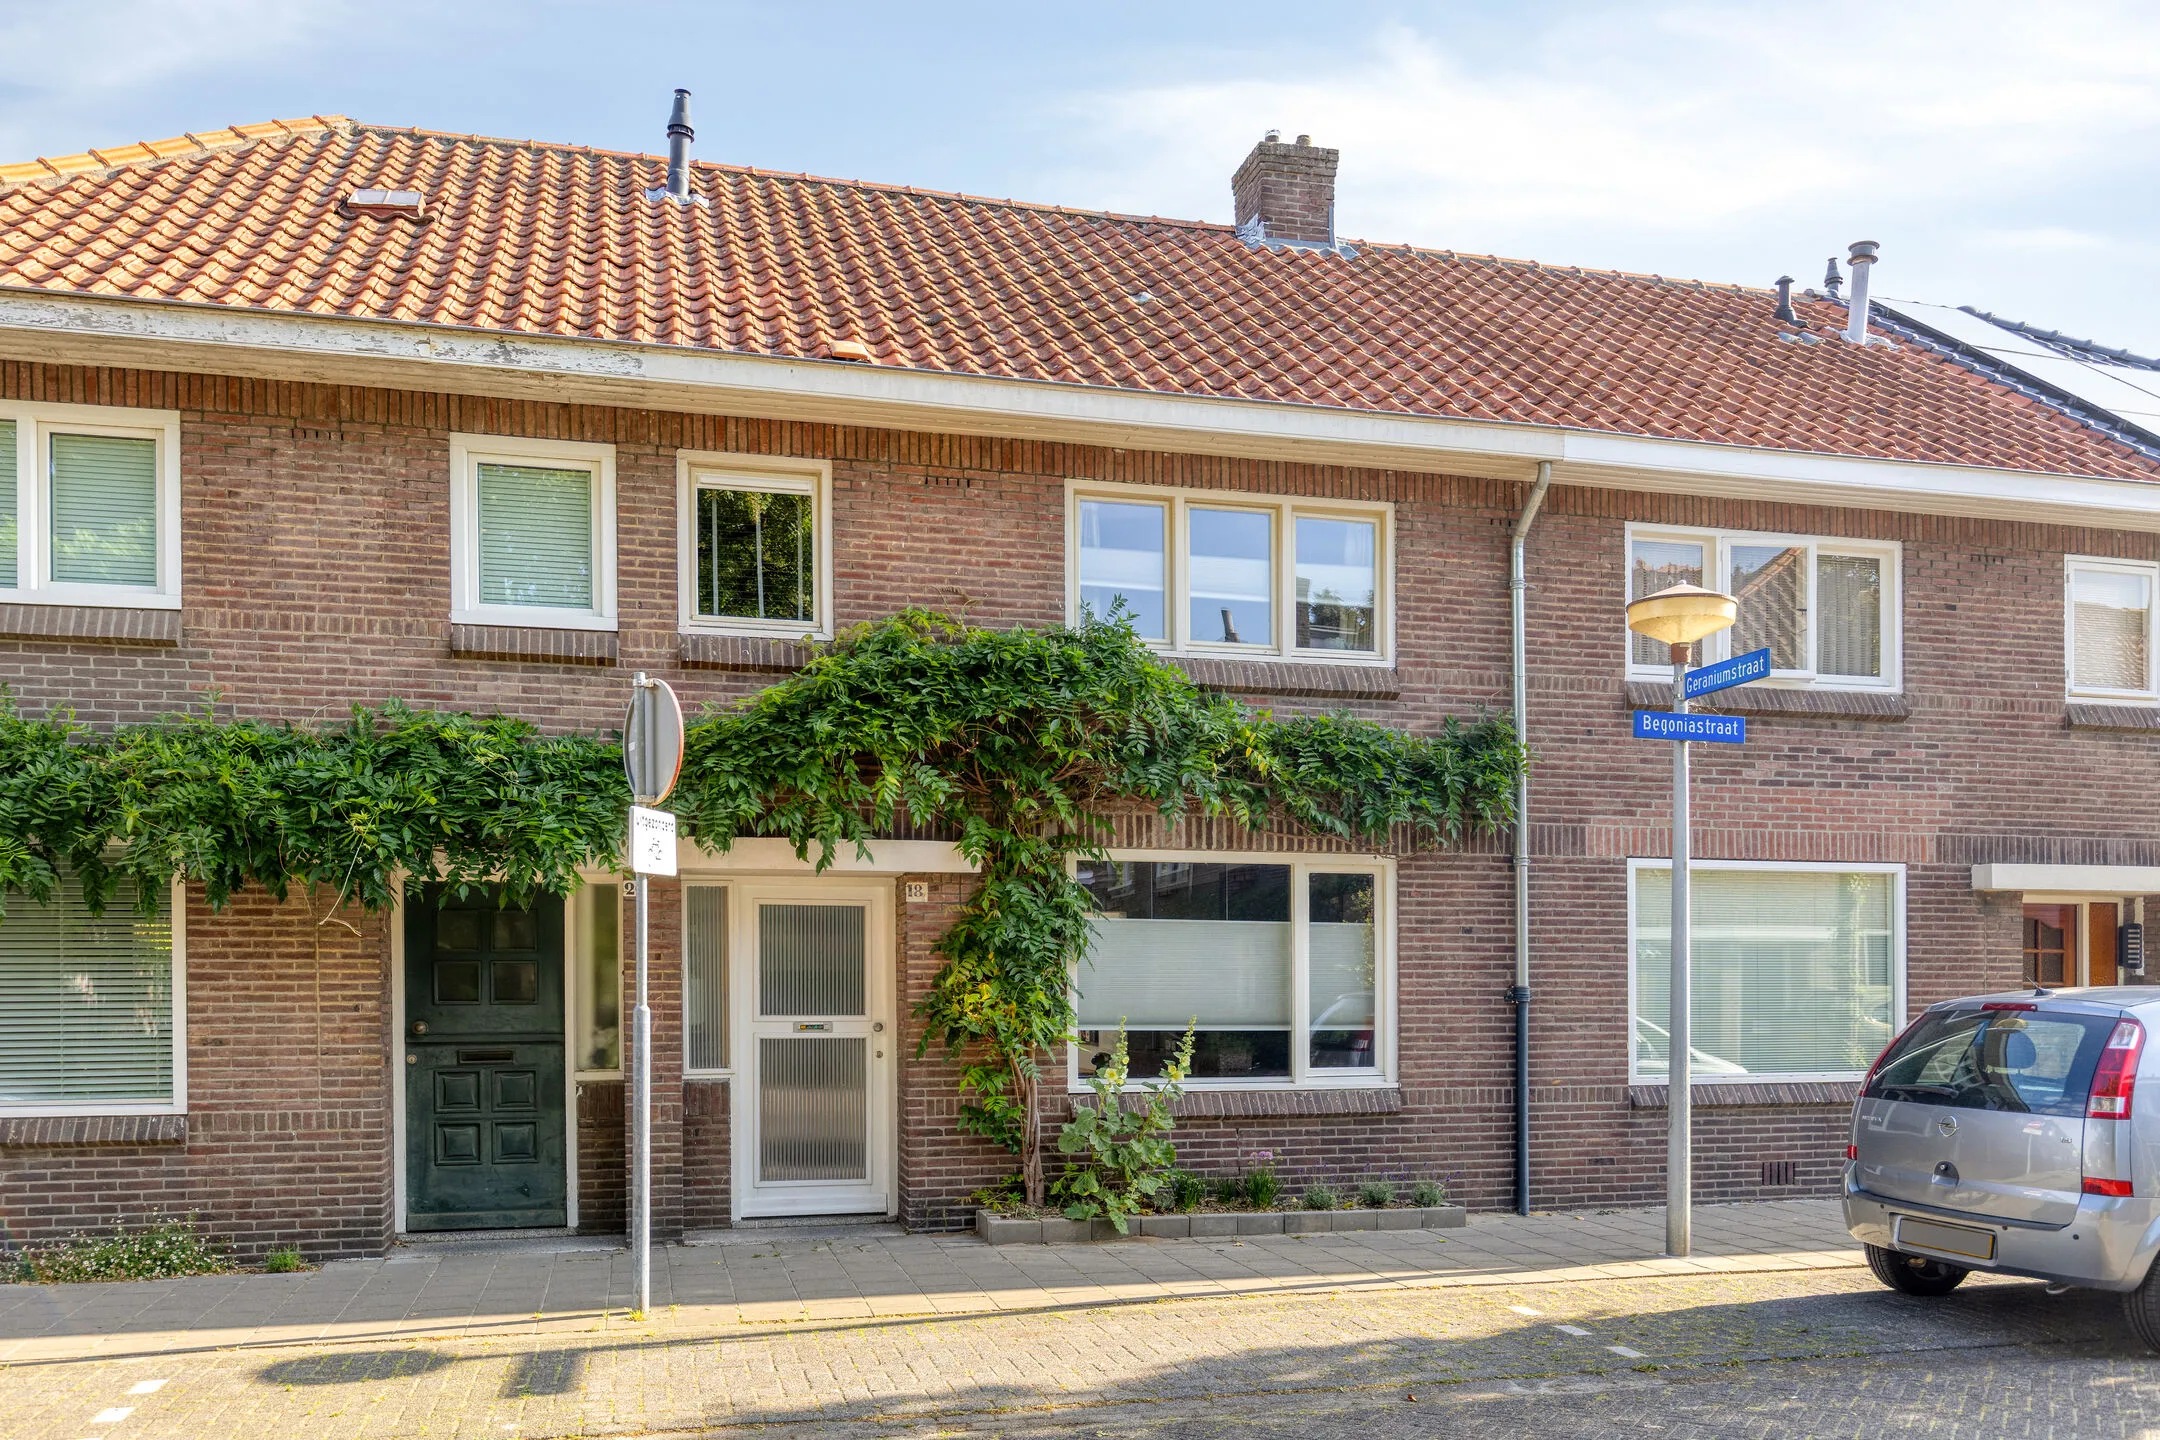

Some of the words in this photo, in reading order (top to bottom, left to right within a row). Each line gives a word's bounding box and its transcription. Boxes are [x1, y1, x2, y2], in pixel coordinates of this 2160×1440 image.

[1686, 655, 1765, 693] Geraniumstraat
[1642, 714, 1739, 736] Begoniastraat
[624, 881, 637, 896] 2
[906, 884, 924, 898] 18
